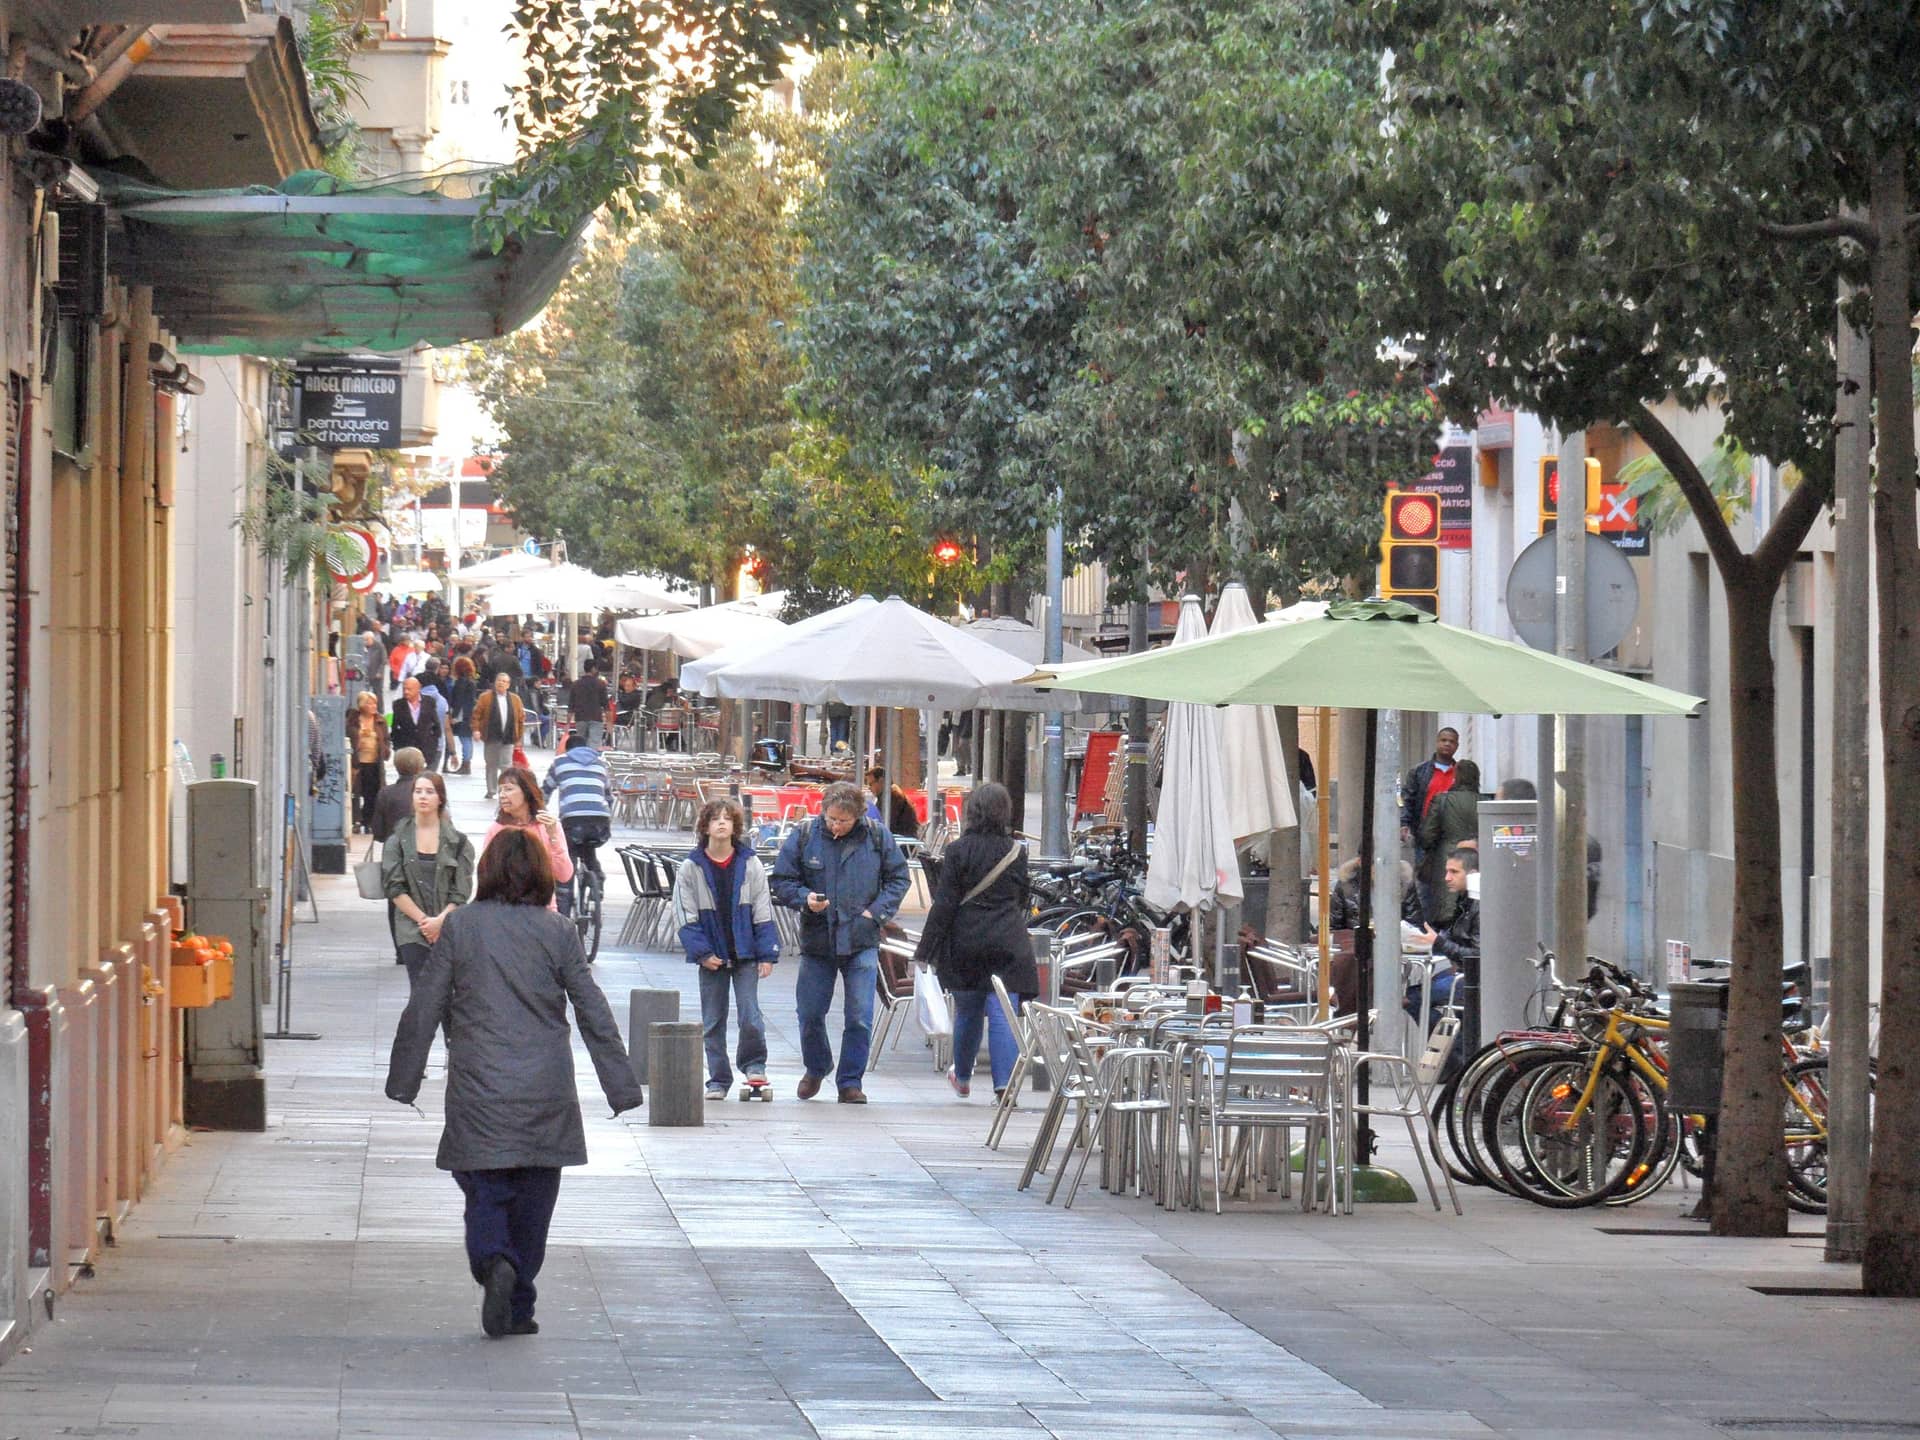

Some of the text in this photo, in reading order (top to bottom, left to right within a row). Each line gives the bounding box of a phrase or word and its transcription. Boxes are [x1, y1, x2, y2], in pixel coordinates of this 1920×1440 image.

[305, 376, 396, 394] ANGEL MANCEBO
[308, 419, 389, 431] perruqueria
[318, 431, 380, 443] d'homes
[1441, 499, 1470, 507] MÀTICS
